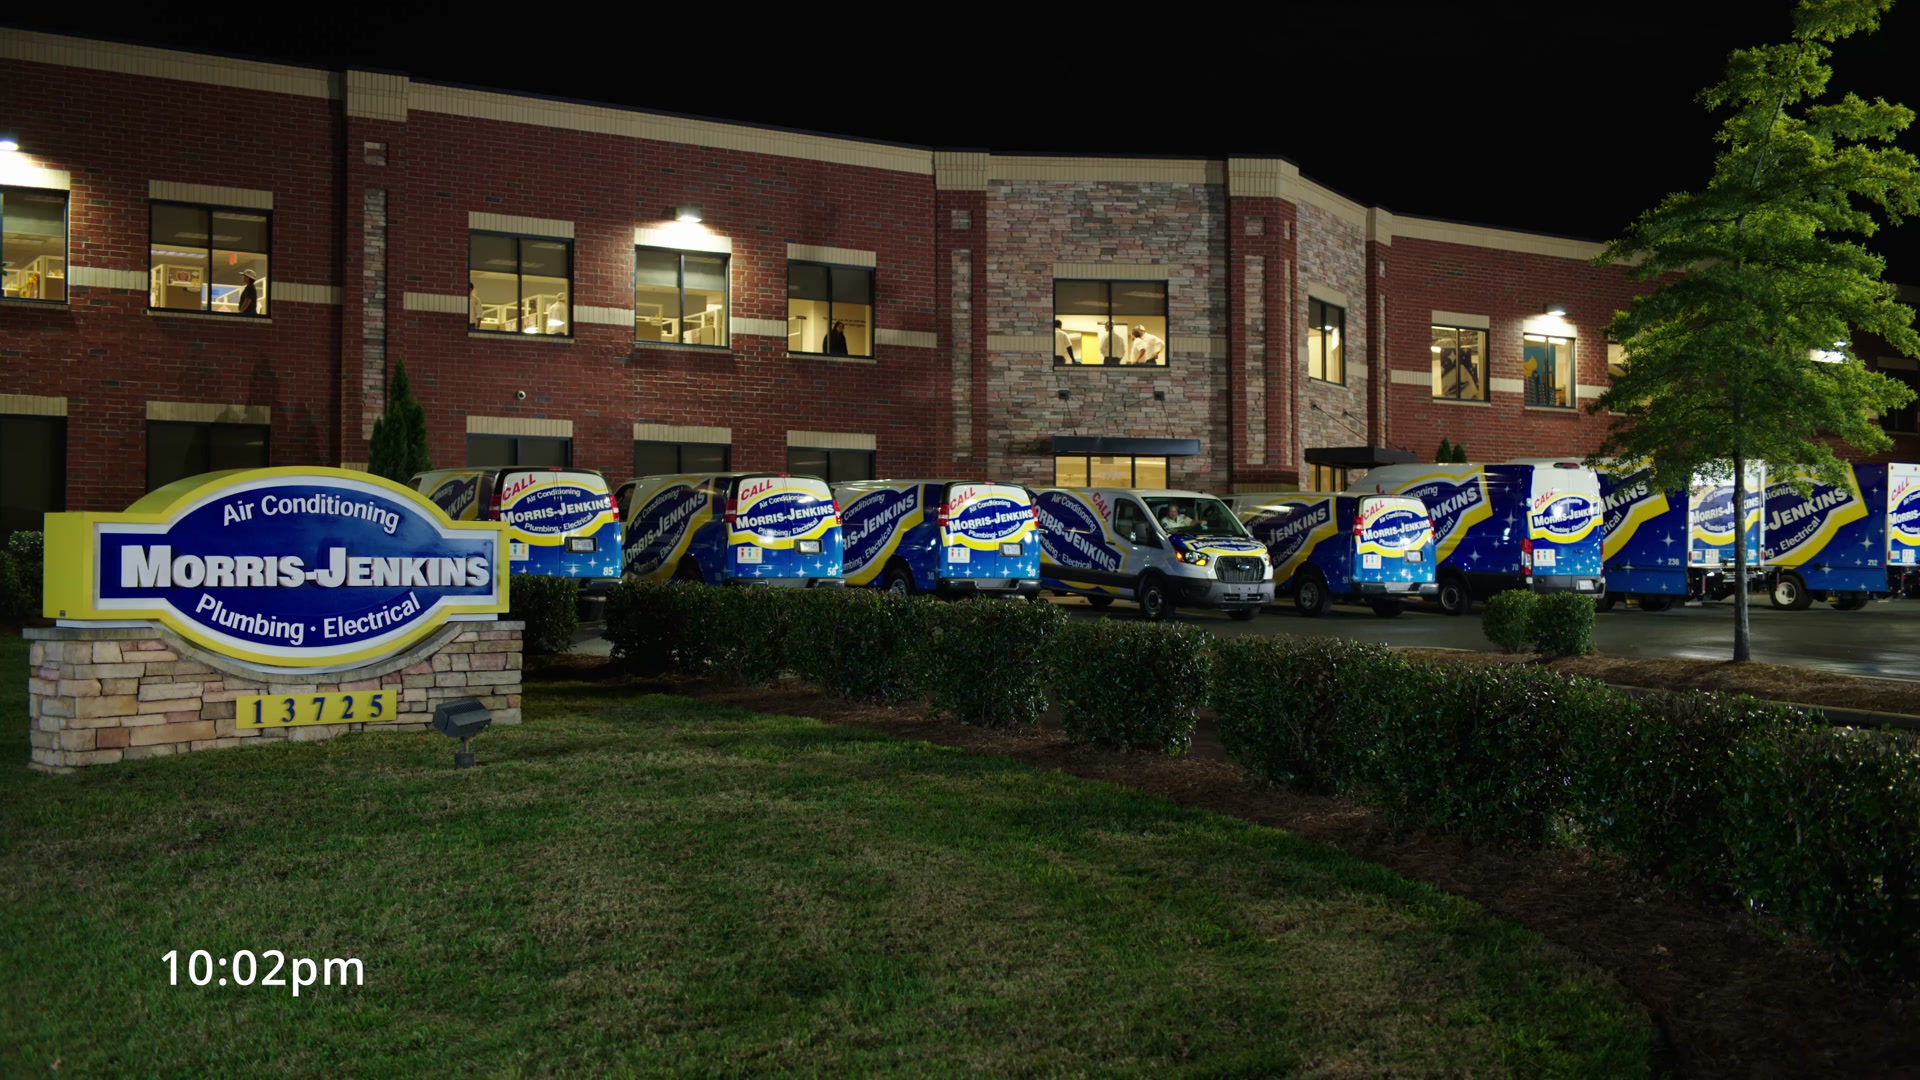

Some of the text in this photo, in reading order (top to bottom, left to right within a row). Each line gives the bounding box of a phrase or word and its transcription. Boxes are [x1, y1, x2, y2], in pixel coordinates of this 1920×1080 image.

[502, 473, 536, 501] CALL
[526, 488, 581, 504] Air Conditioning
[741, 479, 773, 501] CALL
[950, 487, 976, 511] CALL
[222, 494, 400, 534] Air Conditioning
[500, 497, 612, 524] MORRIS-JENKINS
[736, 504, 834, 530] MORRIS-JENKINS
[759, 501, 769, 509] Air
[843, 493, 886, 521] Conditioning
[1051, 493, 1097, 533] Air Conditioning
[1092, 492, 1112, 522] CALL
[1364, 500, 1385, 520] CALL
[524, 512, 594, 534] Plumbing Electrical
[792, 517, 819, 534] Electrical
[948, 509, 1034, 532] MORRIS-JENKINS
[1363, 519, 1431, 541] MORRIS-JENKINS
[1779, 515, 1821, 551] Electrical
[864, 523, 893, 560] Electrical
[1273, 534, 1304, 565] Electrical
[120, 544, 490, 588] MORRIS-JENKINS
[603, 566, 614, 576] 85
[196, 591, 421, 646] Plumbing Electrical
[251, 694, 384, 725] 13725
